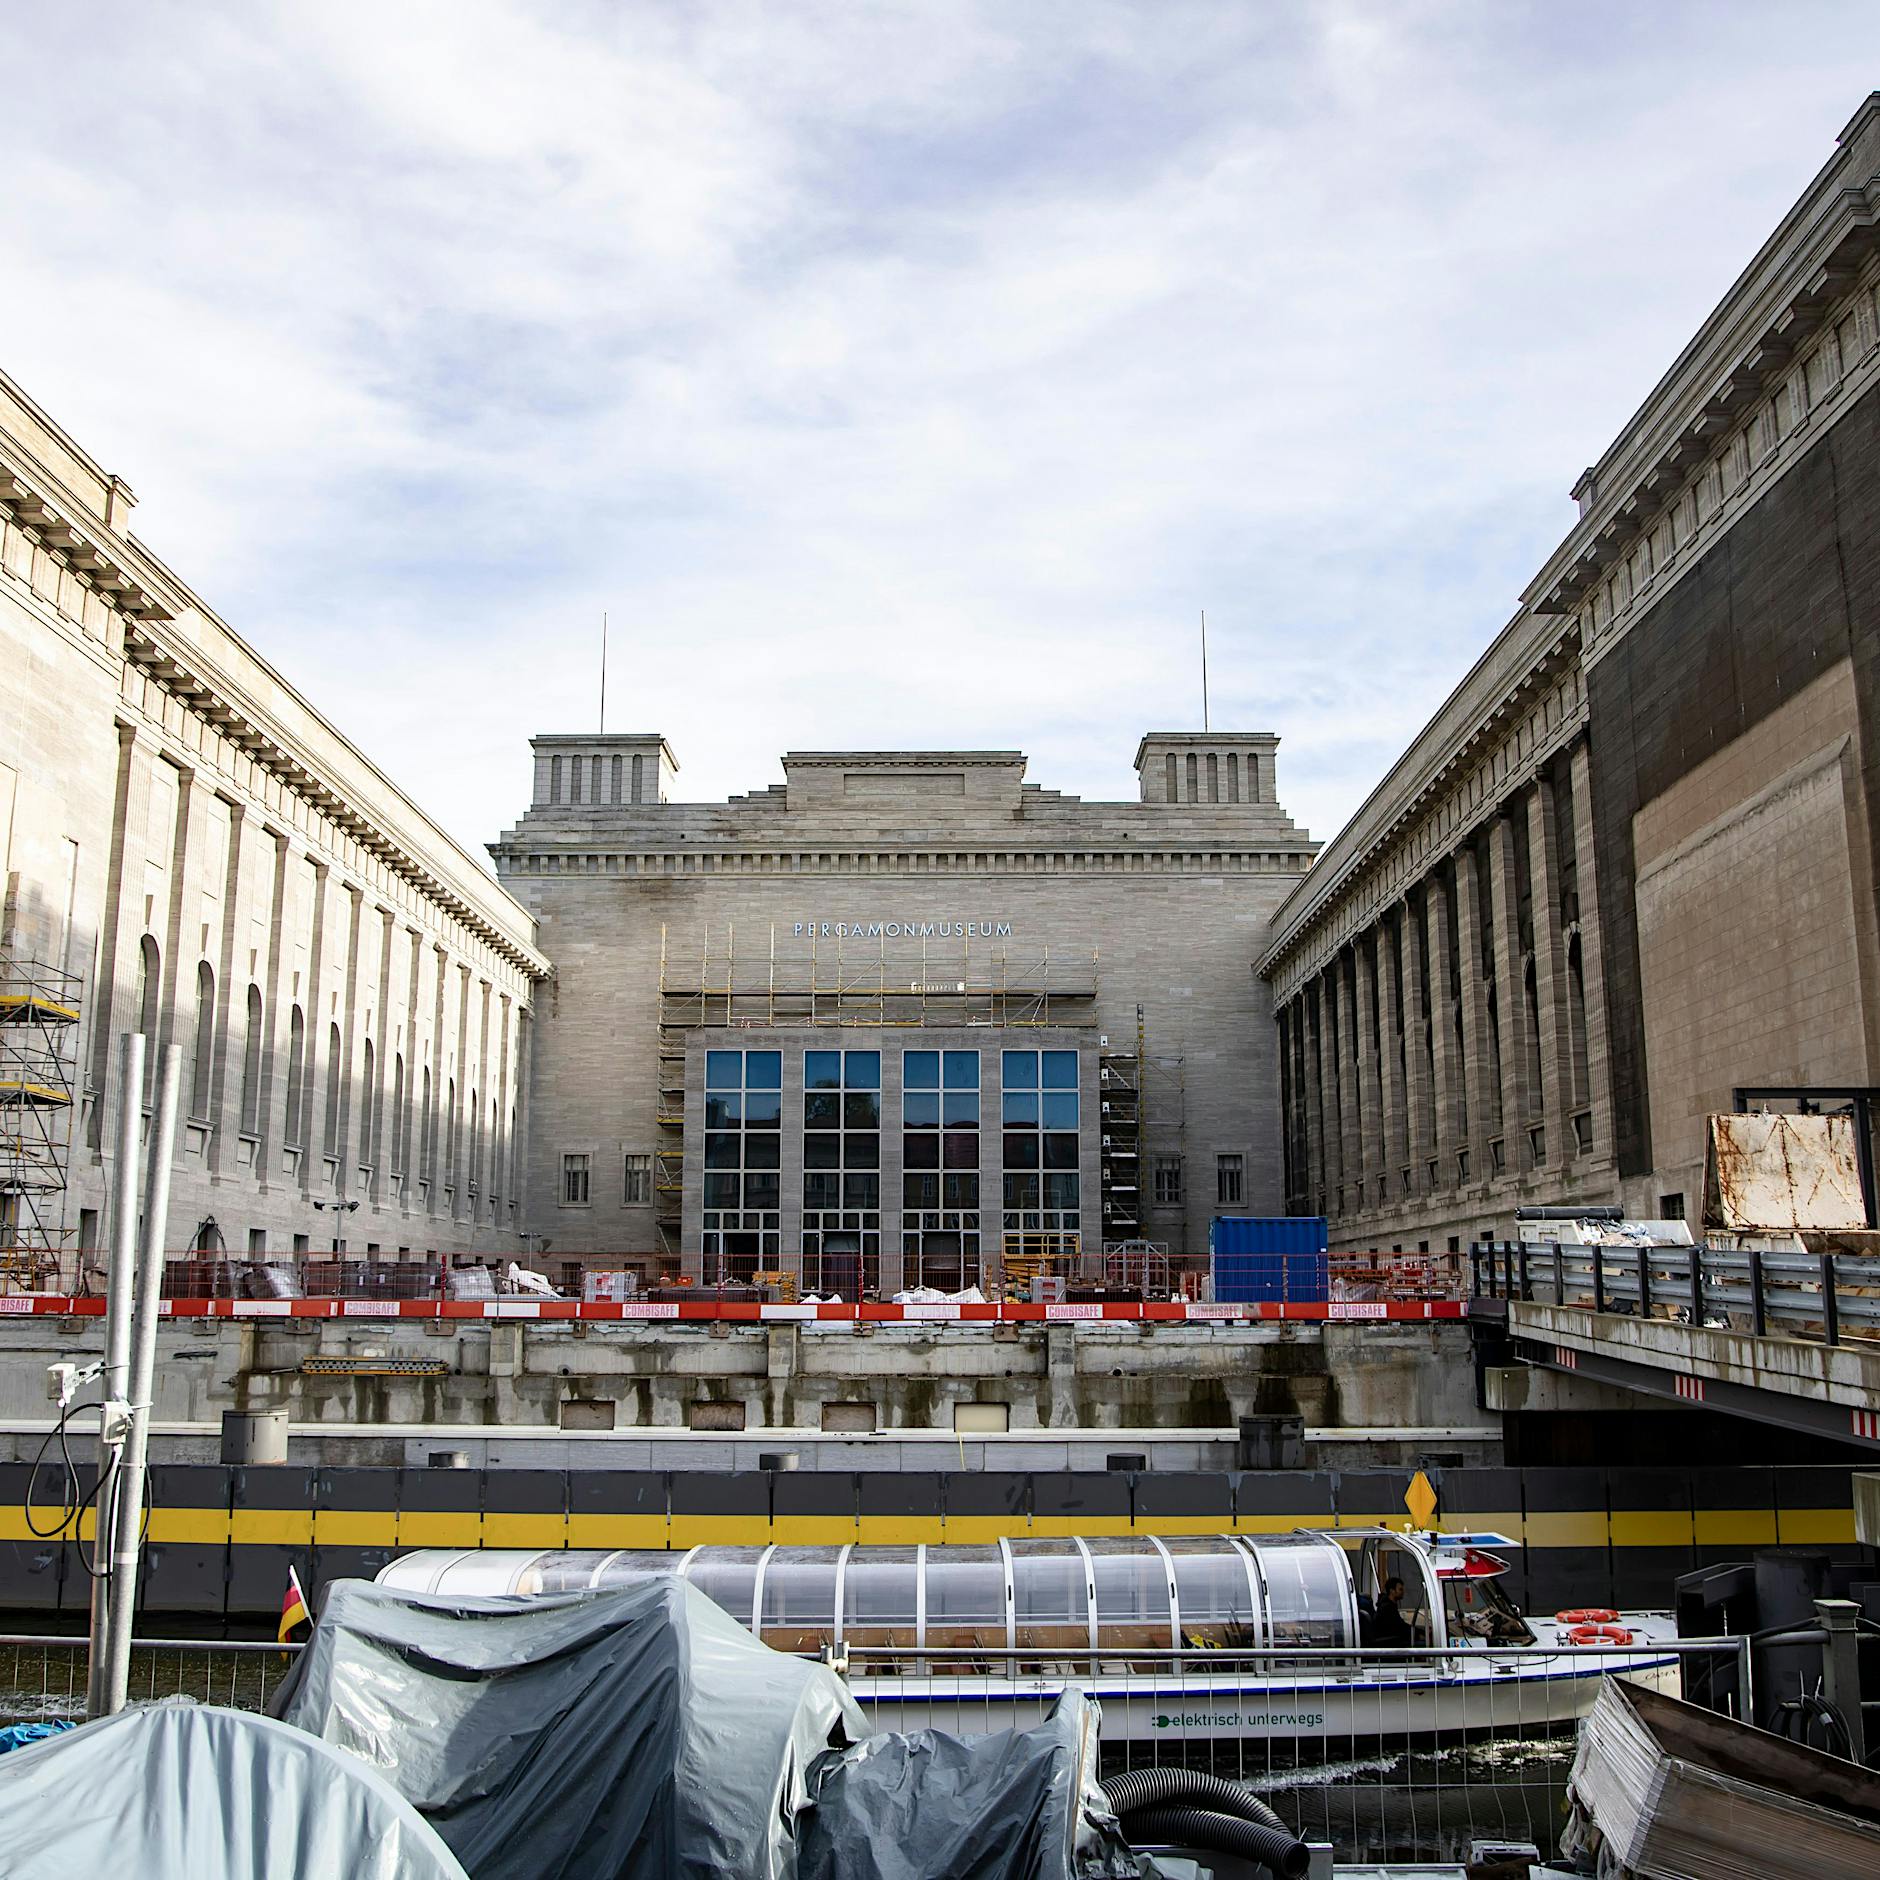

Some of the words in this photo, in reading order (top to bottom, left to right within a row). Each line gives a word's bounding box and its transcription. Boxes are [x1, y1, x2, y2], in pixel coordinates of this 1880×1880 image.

[793, 922, 1013, 937] PERGAMONMUSEUM
[346, 1302, 395, 1314] COMBISAFE
[624, 1304, 675, 1317] COMBISAFE
[1049, 1305, 1098, 1317] COMBISAFE
[1188, 1305, 1239, 1317] COMBISAFE
[1173, 1713, 1242, 1726] elektrisch
[1248, 1713, 1323, 1727] unterwegs
